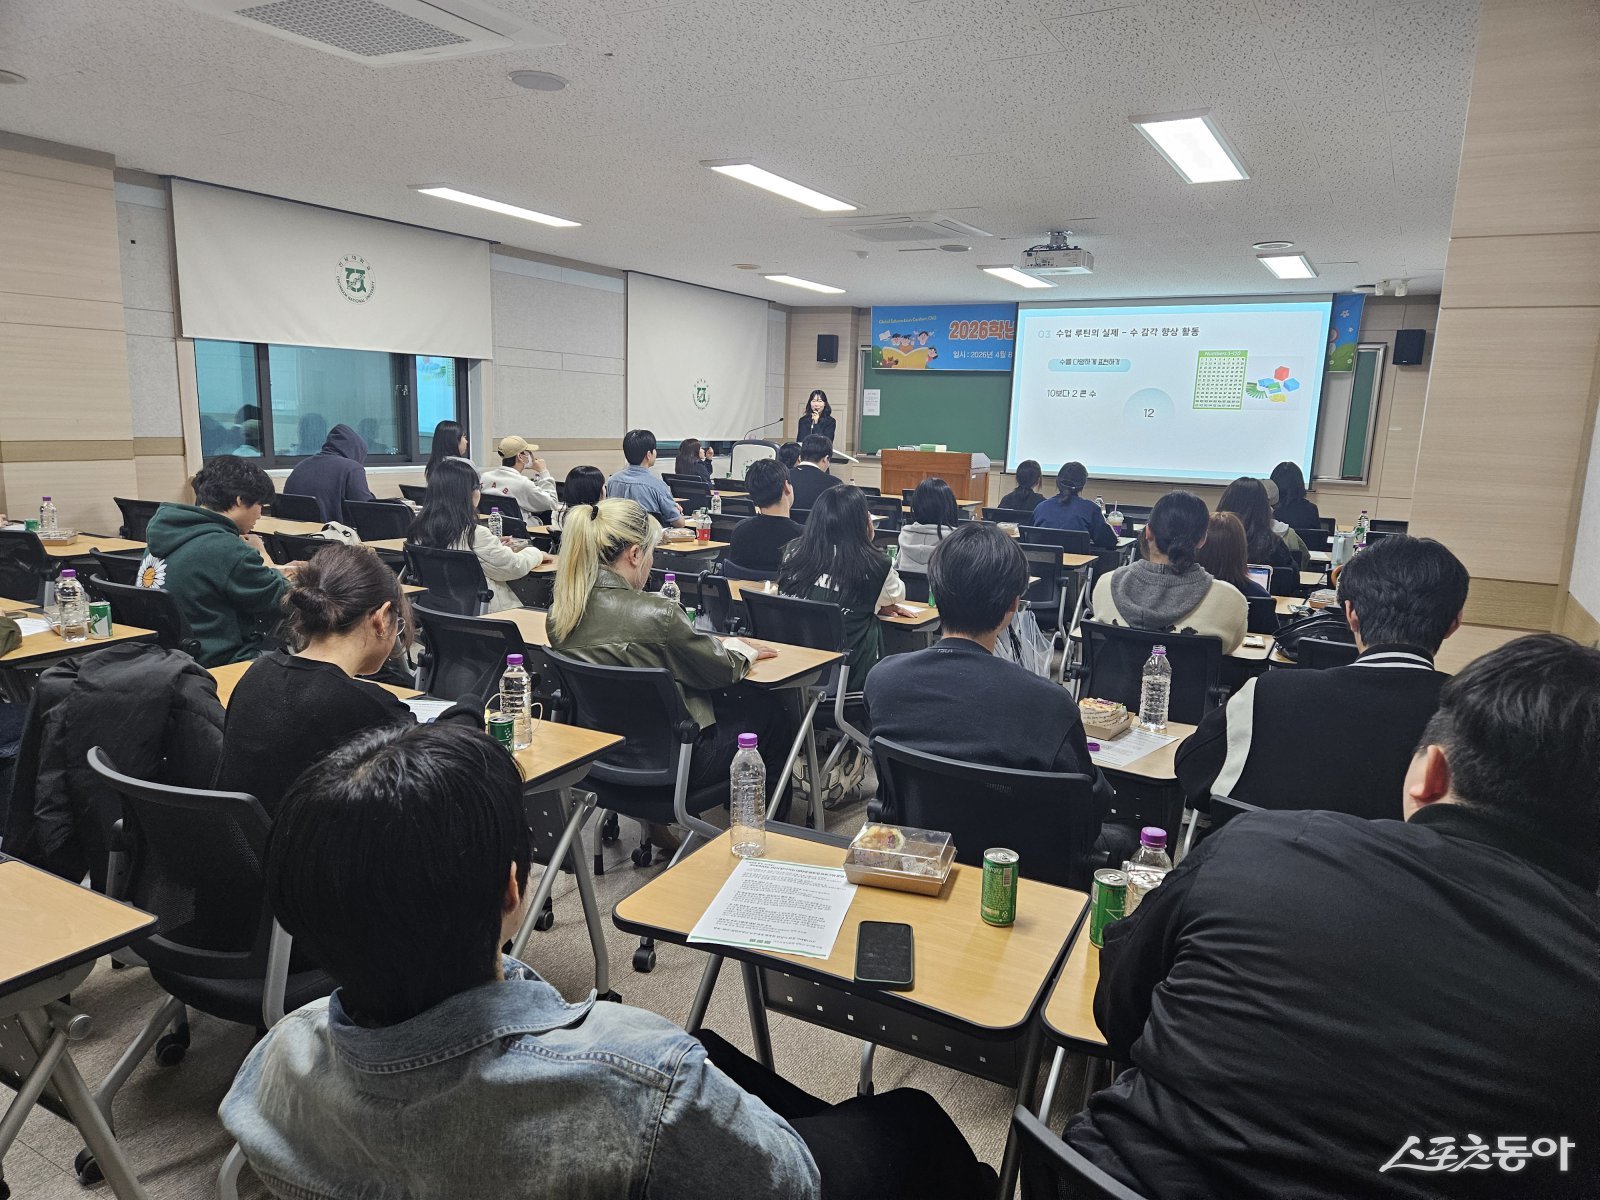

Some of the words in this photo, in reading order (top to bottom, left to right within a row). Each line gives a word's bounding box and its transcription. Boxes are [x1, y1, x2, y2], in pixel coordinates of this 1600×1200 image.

[1056, 329, 1072, 338] 수업
[1075, 328, 1099, 338] 루틴의
[1102, 328, 1119, 338] 실제
[1130, 328, 1139, 337] 수
[1141, 327, 1158, 337] 감각
[1161, 327, 1179, 337] 향상
[1182, 326, 1200, 337] 활동
[1047, 389, 1070, 398] 10보다
[1072, 389, 1078, 398] 2
[1080, 389, 1087, 398] 큰
[1089, 389, 1097, 398] 수
[1143, 408, 1155, 418] 12
